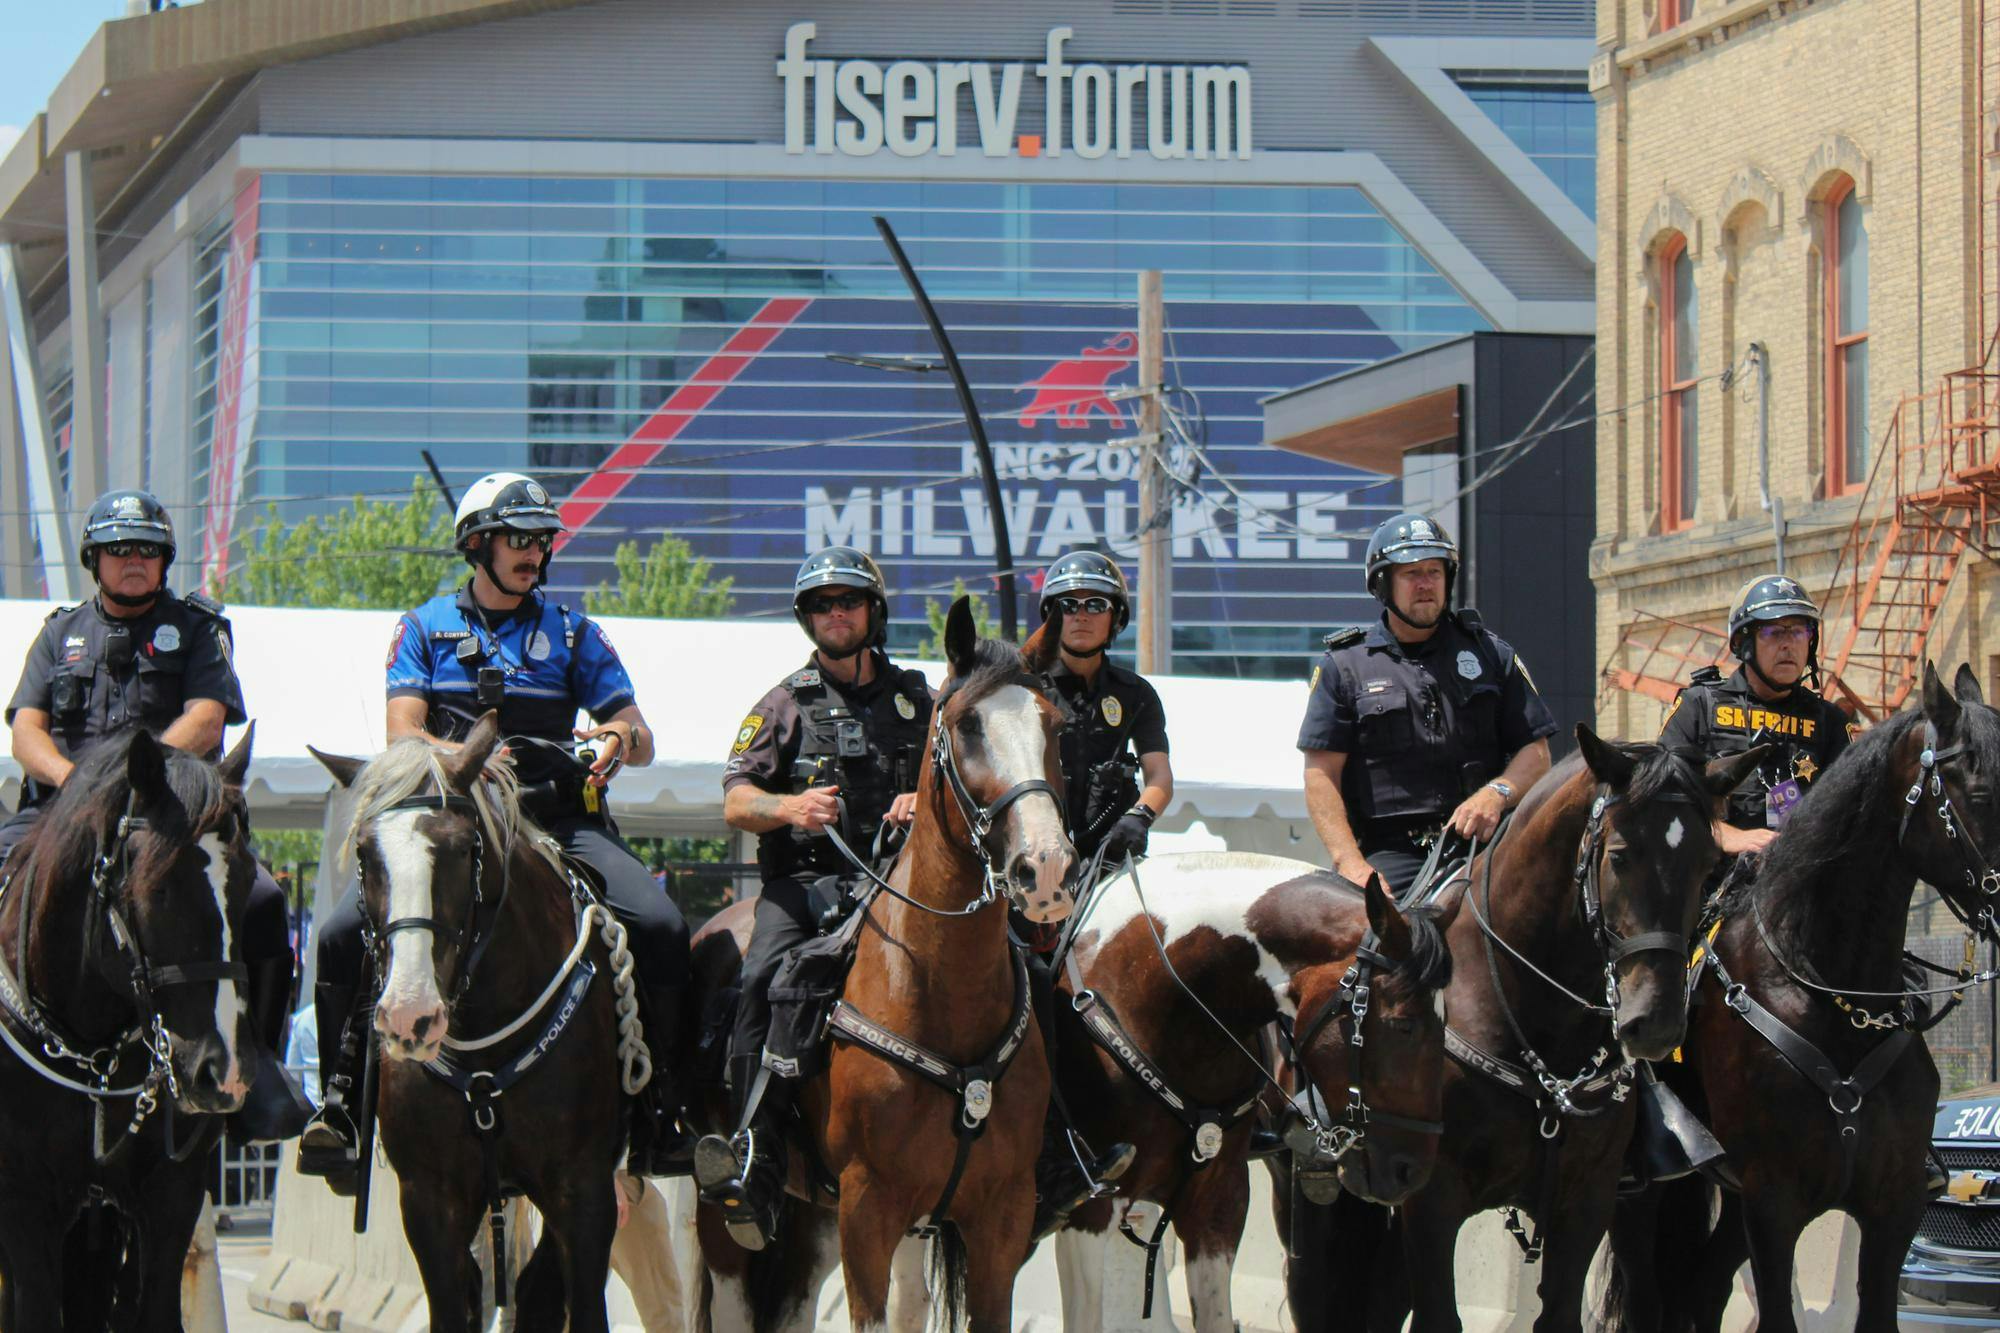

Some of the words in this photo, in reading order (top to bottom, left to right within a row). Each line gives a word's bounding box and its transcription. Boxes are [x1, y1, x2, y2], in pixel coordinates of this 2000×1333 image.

[1036, 27, 1252, 160] forum
[805, 486, 1348, 559] MILWAUKEE
[1716, 706, 1816, 738] SHERIFF
[0, 977, 30, 1022] POLIC
[539, 998, 576, 1052] POLICE
[858, 1023, 918, 1062] POLICE
[1112, 1036, 1163, 1090] POLICE
[1445, 1034, 1495, 1073] OLICE
